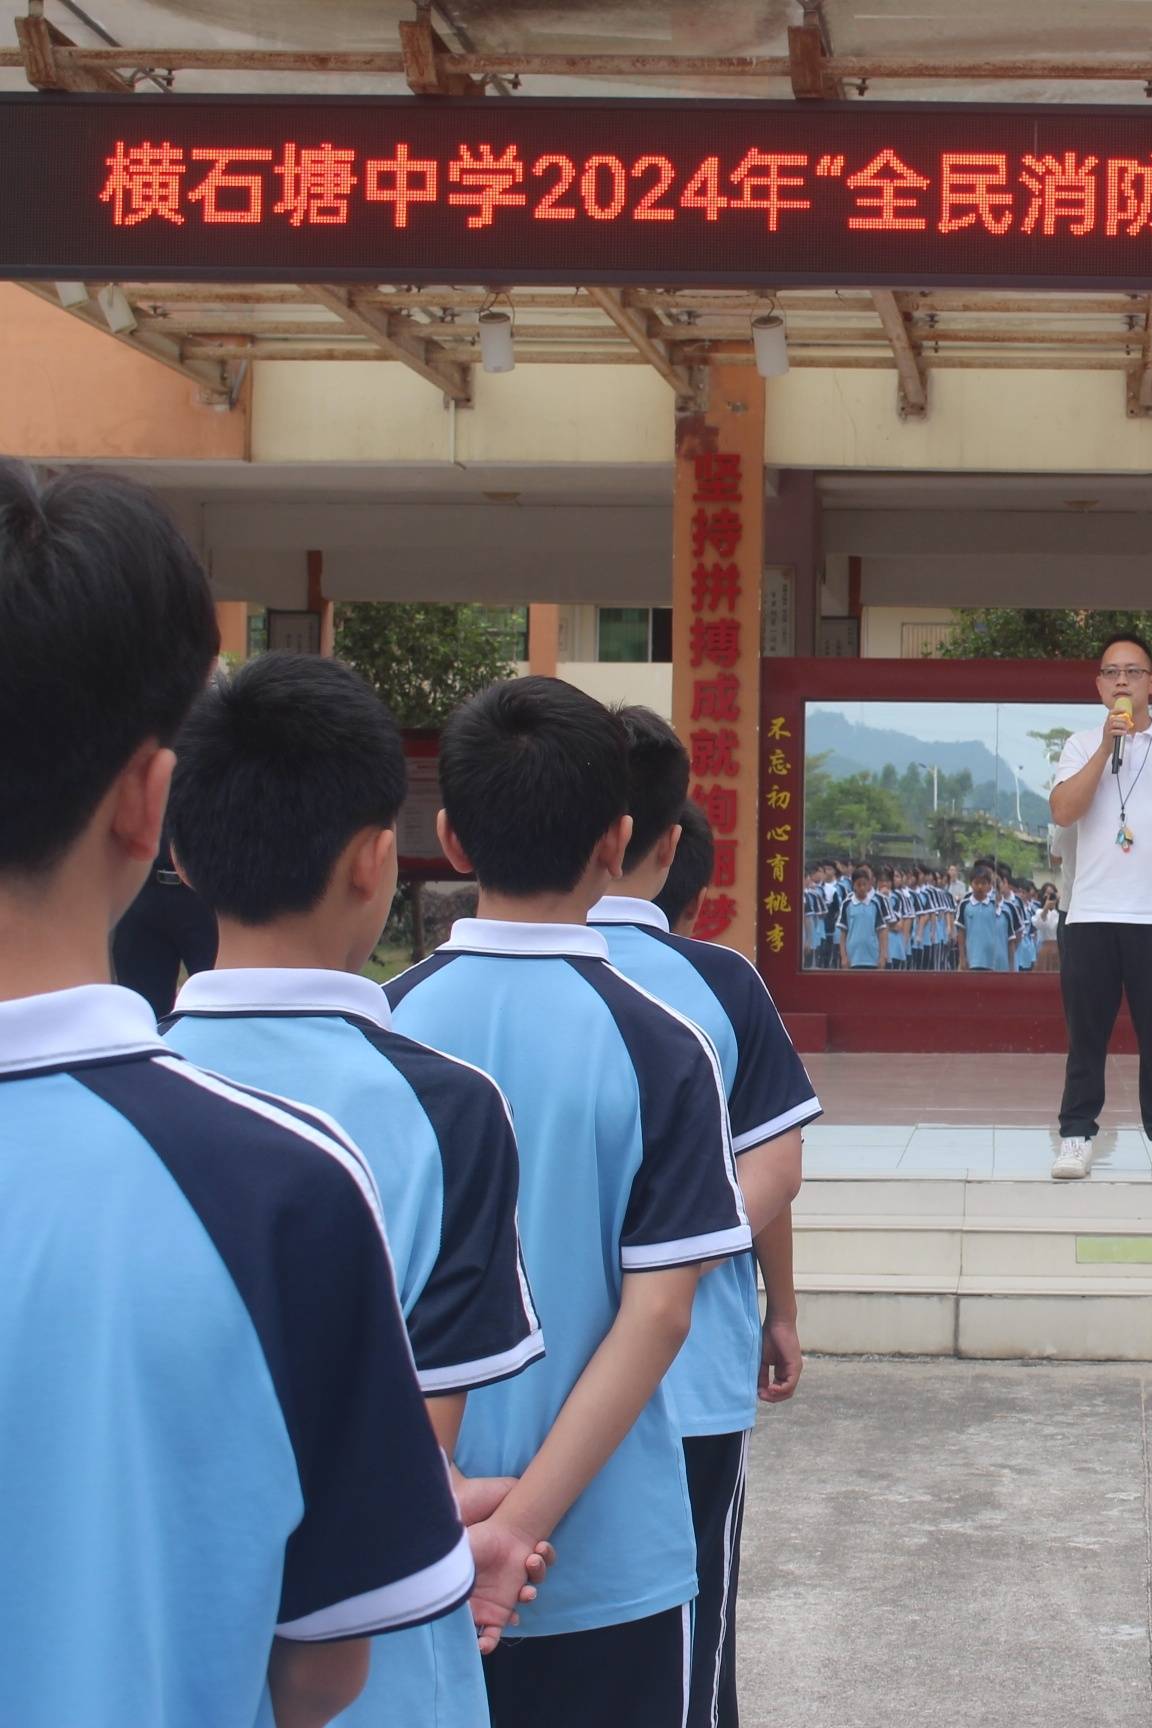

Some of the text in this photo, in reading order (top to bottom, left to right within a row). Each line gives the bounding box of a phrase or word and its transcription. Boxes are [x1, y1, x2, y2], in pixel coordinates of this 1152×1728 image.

[763, 716, 791, 952] 不忘初心育桃李
